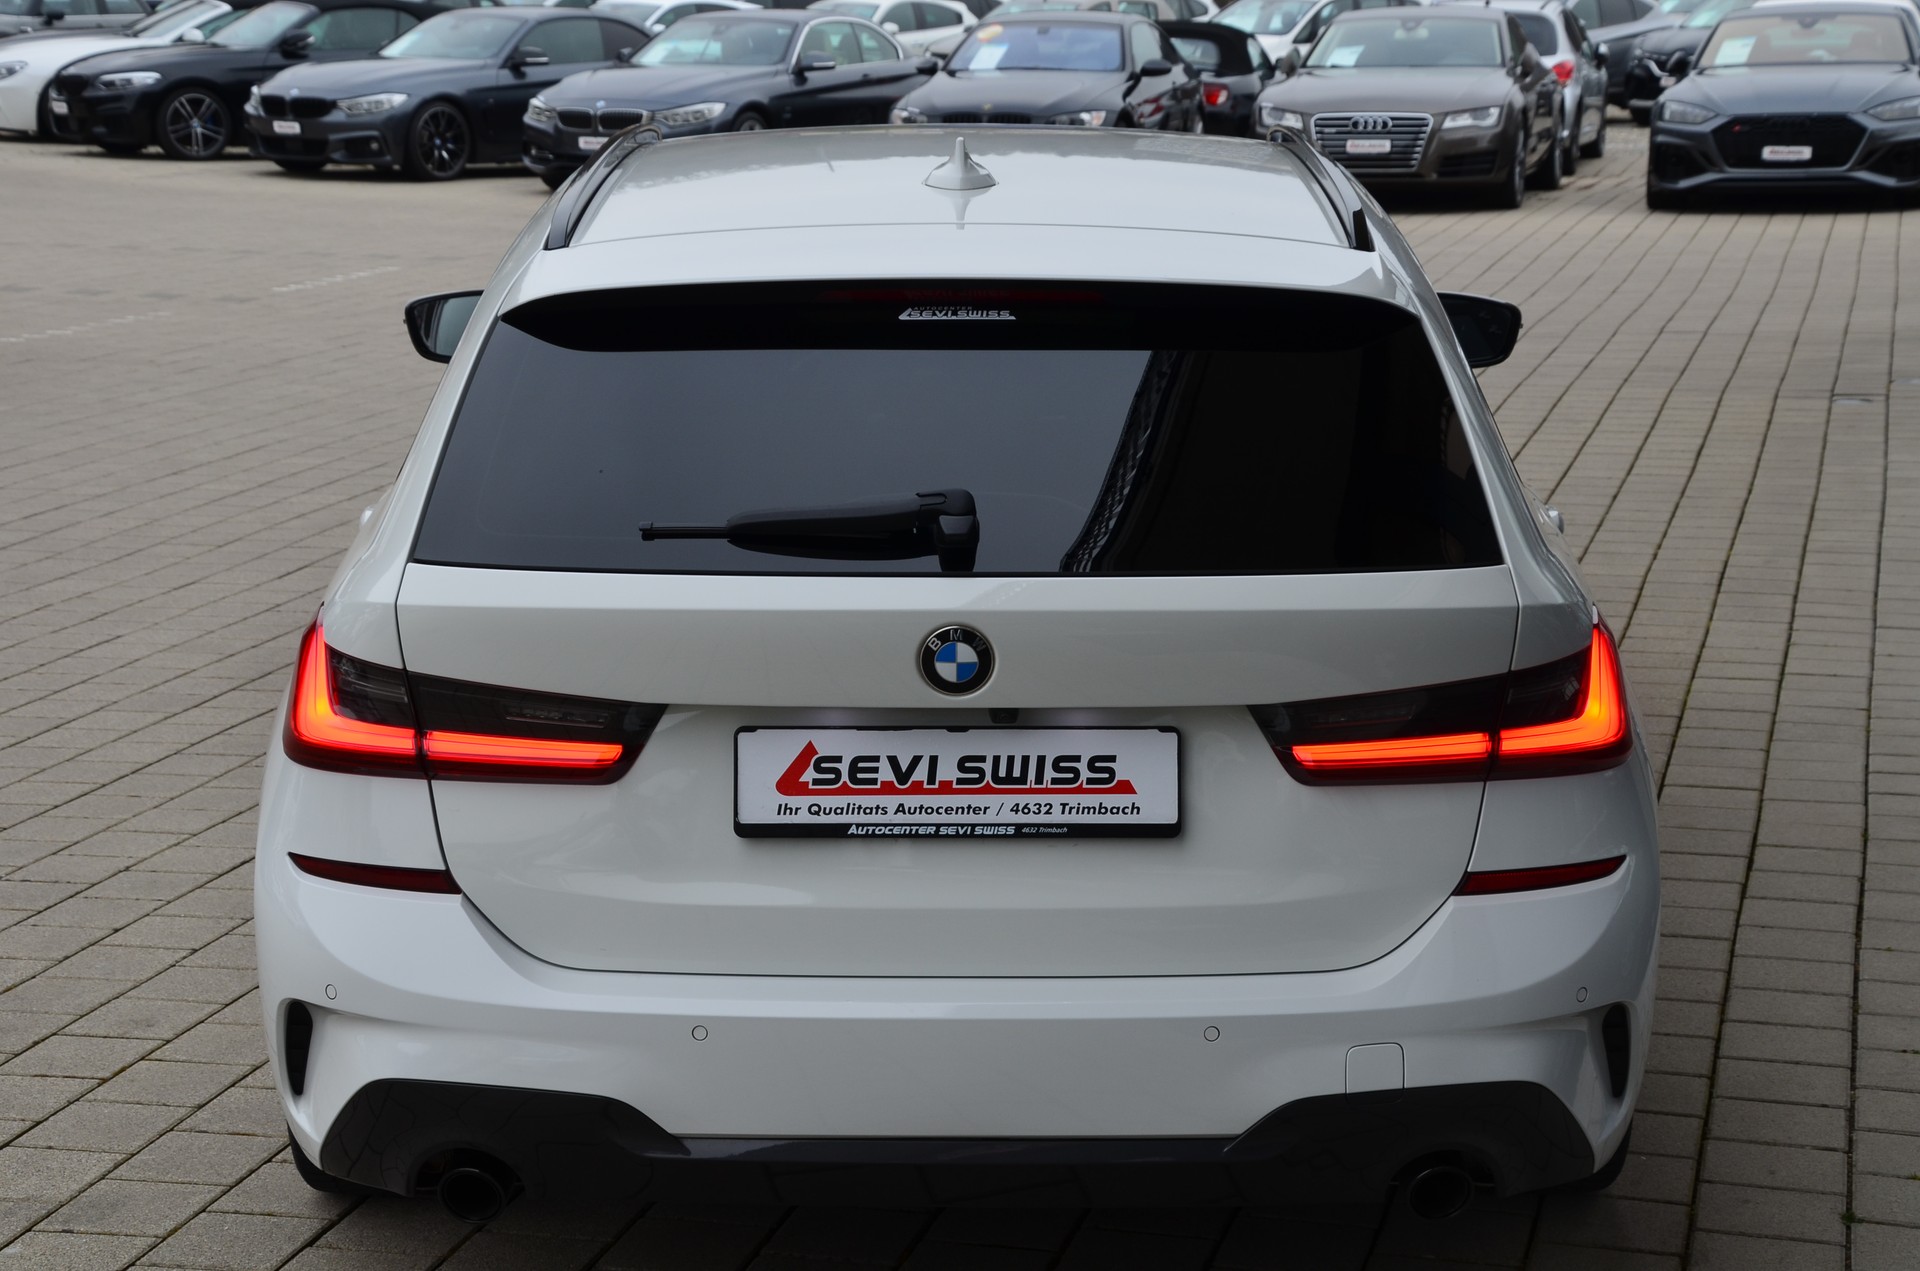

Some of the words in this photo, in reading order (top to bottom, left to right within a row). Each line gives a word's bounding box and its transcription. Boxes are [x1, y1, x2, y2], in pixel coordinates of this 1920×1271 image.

[910, 310, 952, 318] SEVI
[957, 310, 1011, 318] SWISS
[927, 629, 987, 652] BMW
[809, 754, 938, 787] SEVI
[953, 754, 1118, 787] SWISS
[776, 802, 802, 816] Ihr
[807, 802, 889, 816] Qualitats
[893, 802, 990, 816] Autocenter
[995, 802, 1006, 816] /
[1010, 802, 1053, 816] 4632
[1059, 802, 1141, 816] Trimbach
[938, 826, 972, 835] SEVI
[974, 826, 1016, 835] SWISS
